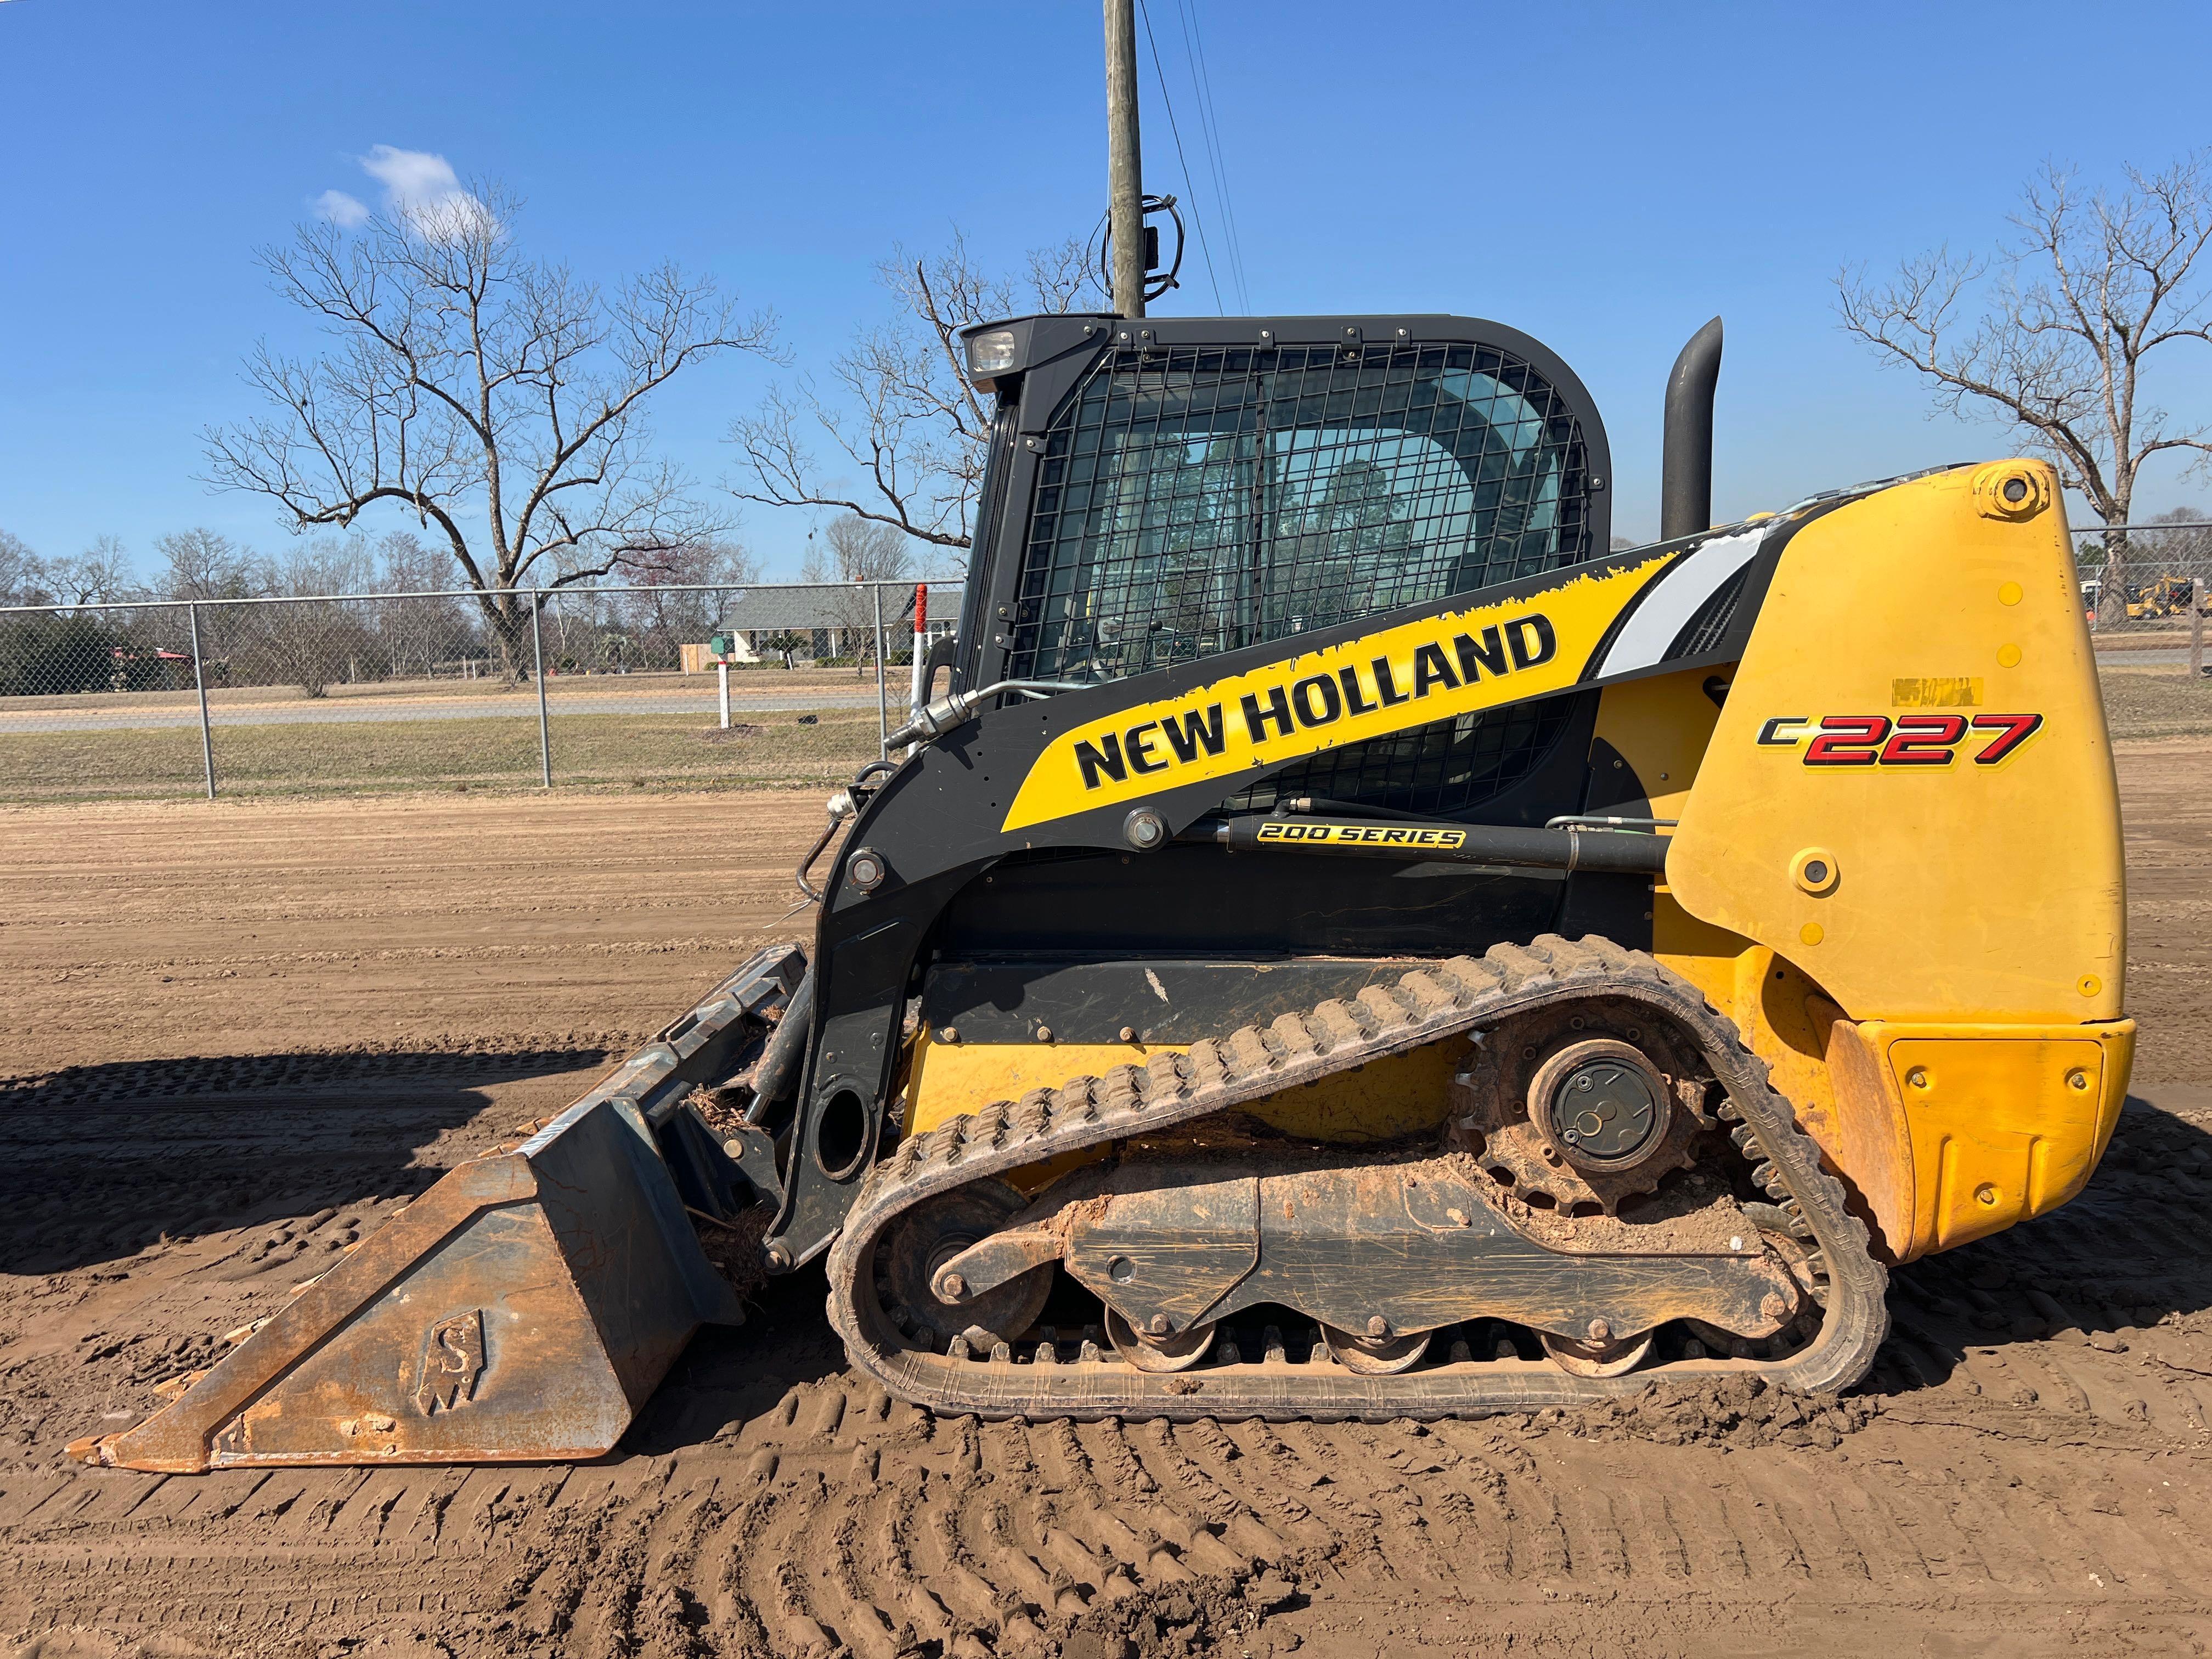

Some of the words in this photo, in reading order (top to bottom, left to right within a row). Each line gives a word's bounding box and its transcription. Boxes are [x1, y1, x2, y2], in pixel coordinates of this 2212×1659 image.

[1074, 702, 1226, 790] NEW
[1240, 613, 1557, 744] HOLLAND
[1261, 825, 1330, 840] 200
[1338, 828, 1464, 844] SERIES
